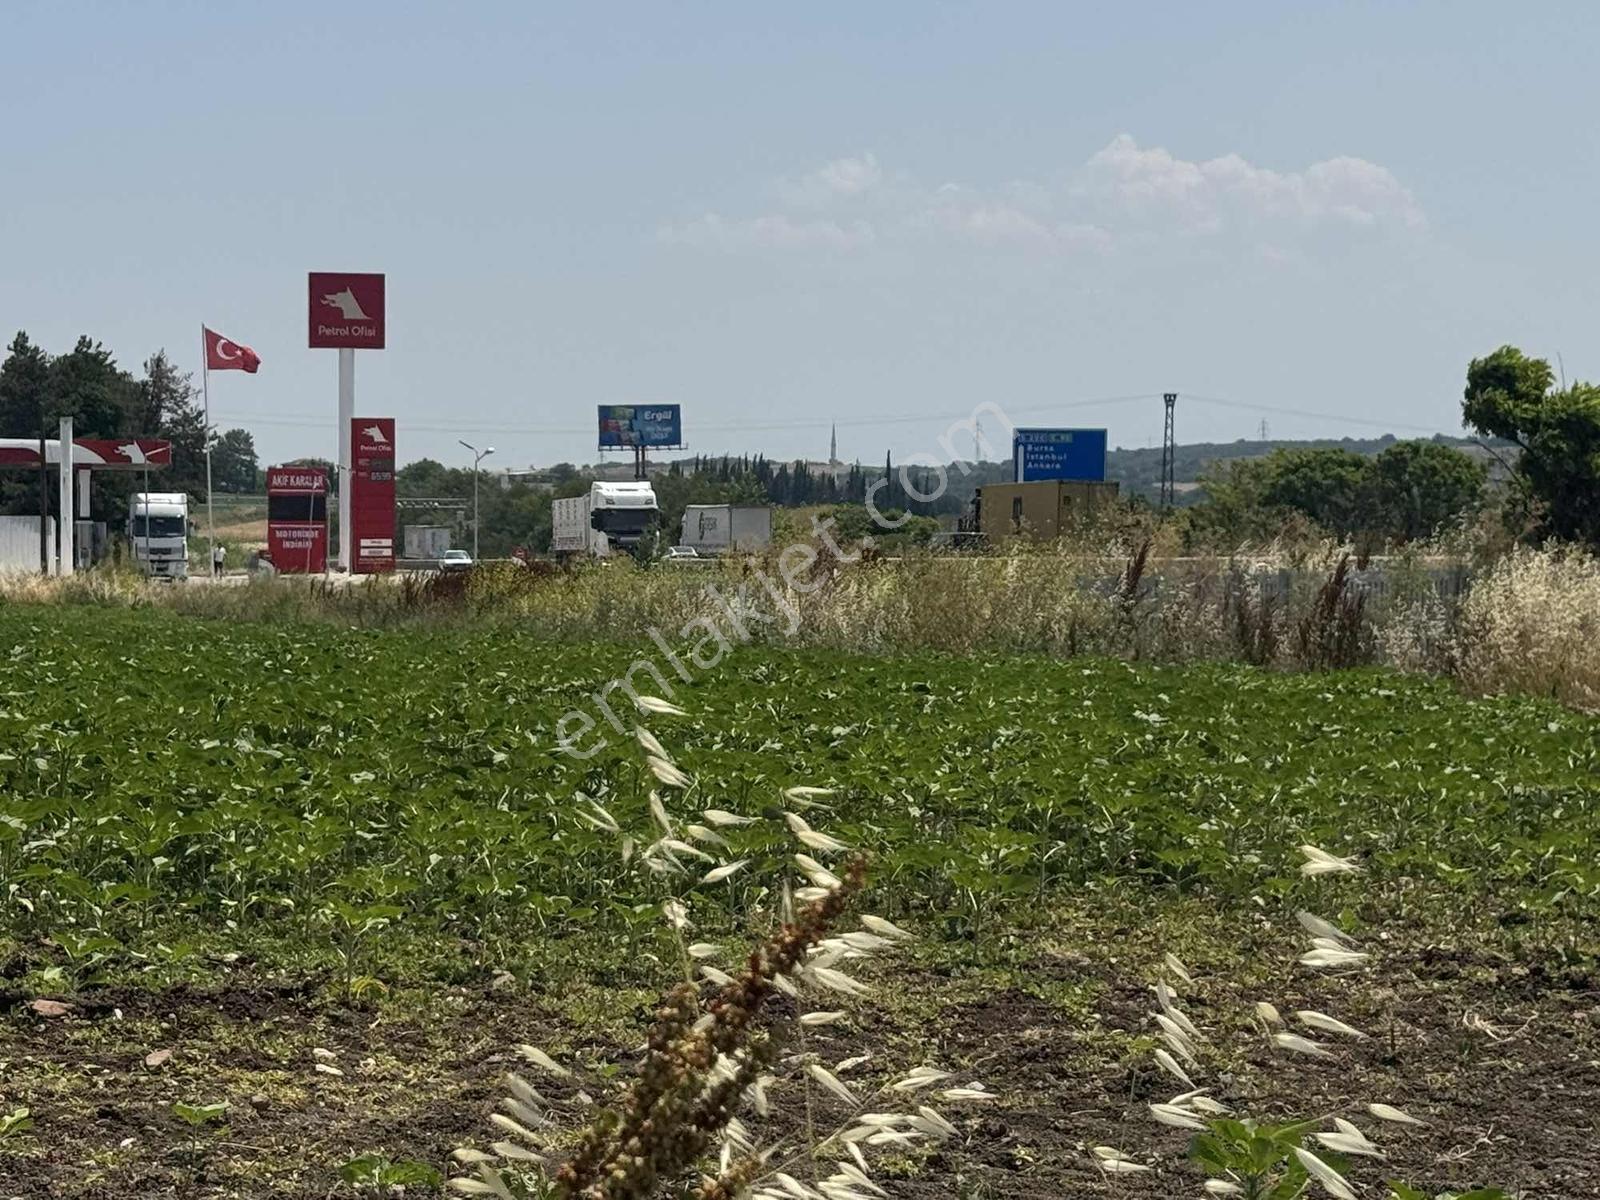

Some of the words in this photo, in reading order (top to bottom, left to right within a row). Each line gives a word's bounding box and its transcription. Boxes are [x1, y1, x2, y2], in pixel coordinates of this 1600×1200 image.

[318, 325, 349, 336] Petrol
[352, 326, 376, 337] Ofisi
[1027, 444, 1054, 452] Bursa
[1027, 461, 1061, 469] Ankara
